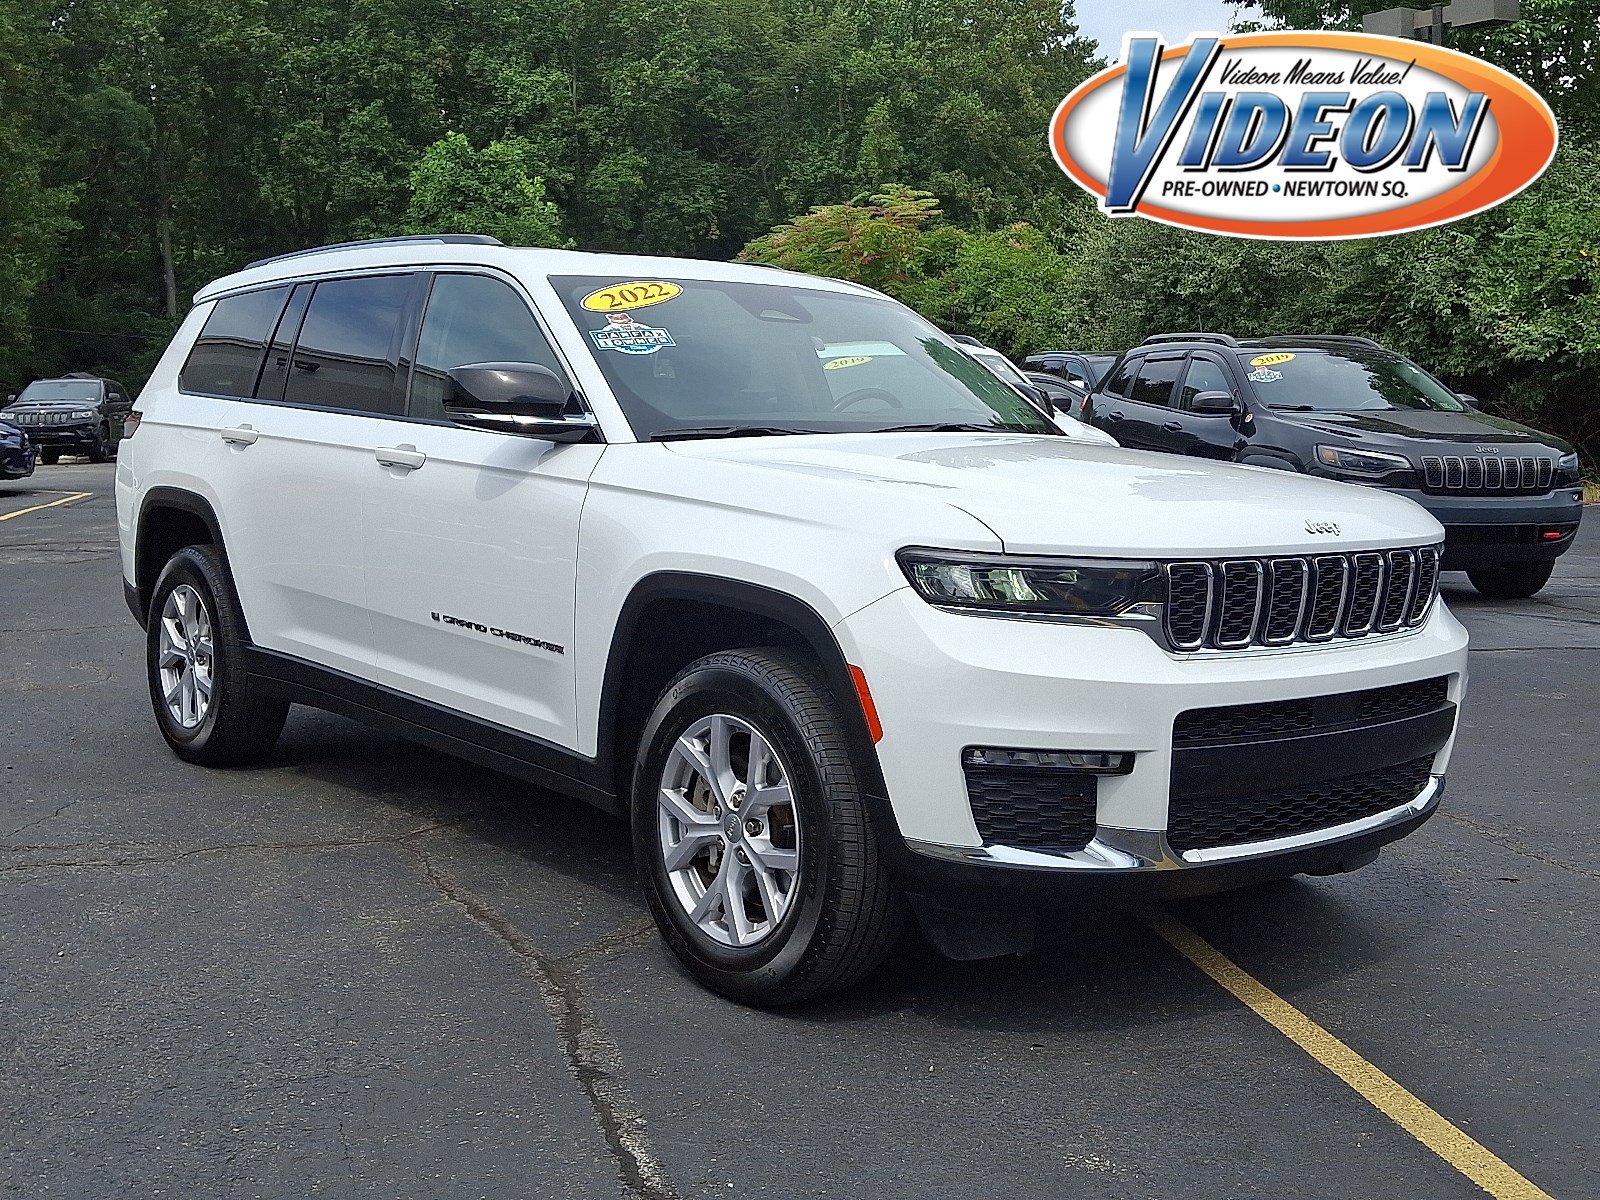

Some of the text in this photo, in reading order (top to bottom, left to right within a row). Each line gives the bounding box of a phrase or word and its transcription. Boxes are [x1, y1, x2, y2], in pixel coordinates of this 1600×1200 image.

[600, 284, 670, 308] 2022
[596, 330, 664, 340] CARFAX
[1475, 445, 1499, 454] Jeep
[1304, 519, 1341, 536] Jeep
[443, 615, 565, 655] GRAND CHEROKEE
